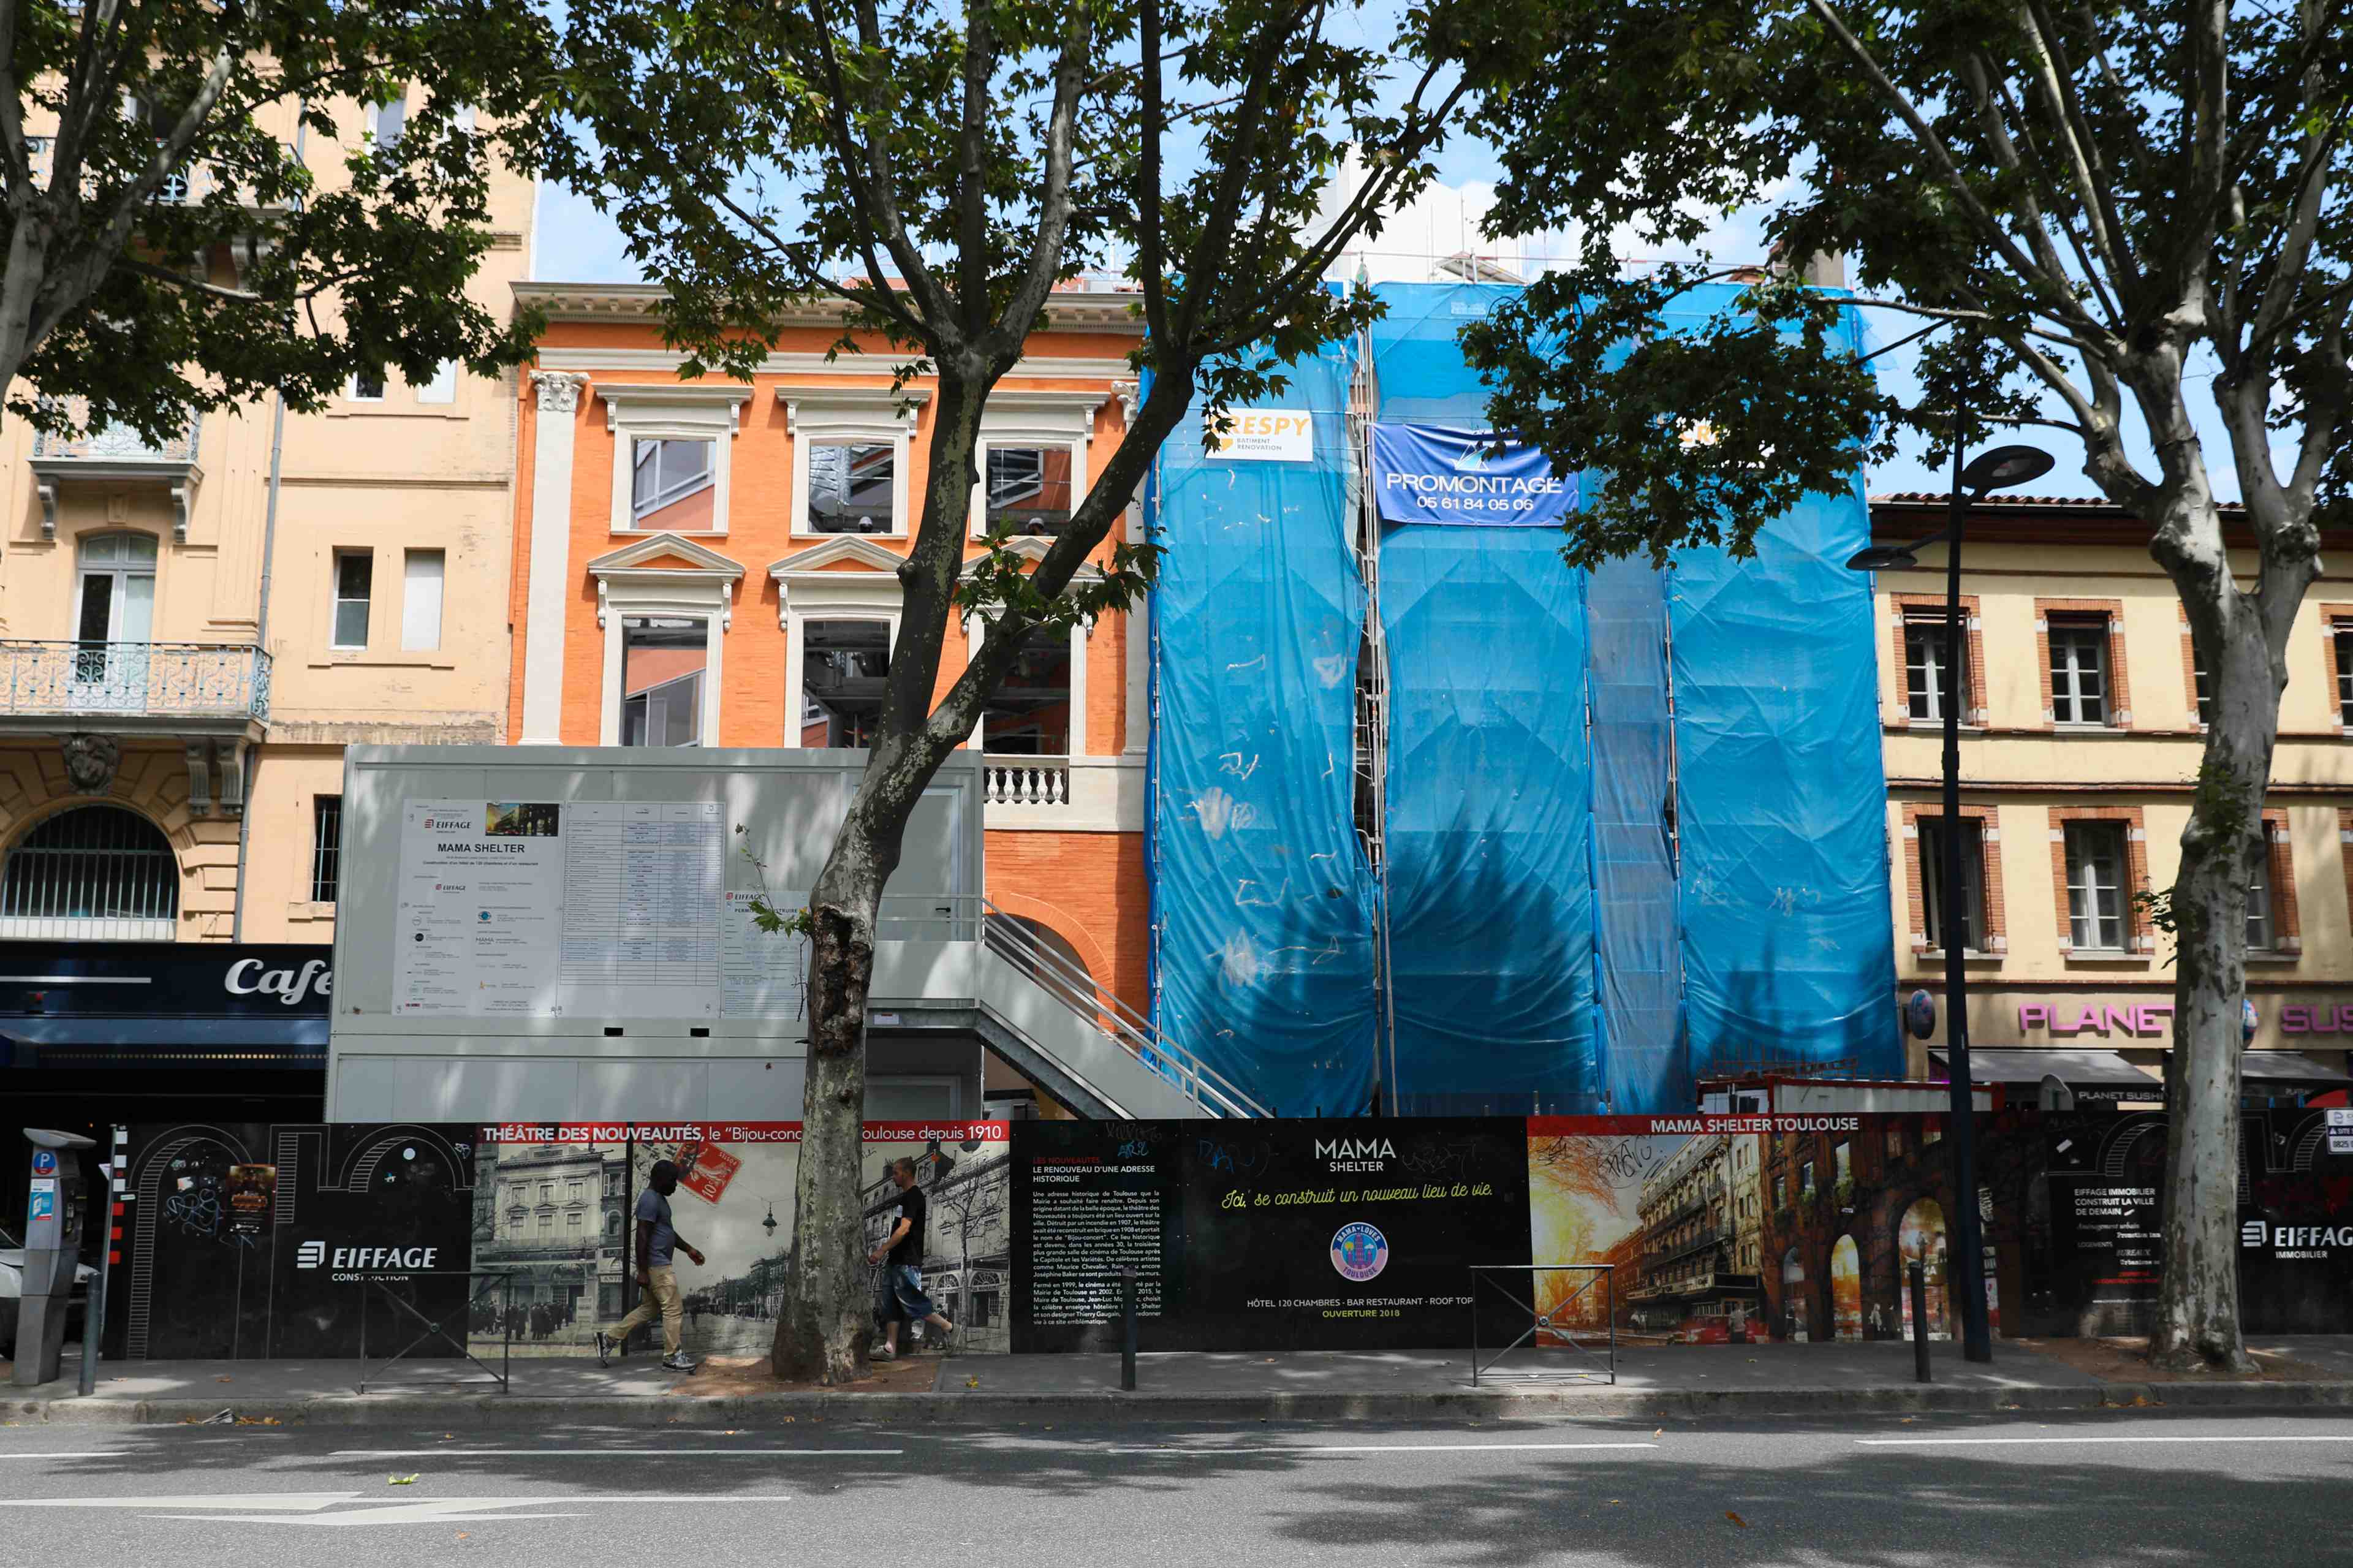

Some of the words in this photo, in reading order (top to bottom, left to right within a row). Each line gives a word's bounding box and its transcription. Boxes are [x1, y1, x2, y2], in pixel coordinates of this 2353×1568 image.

[1386, 472, 1563, 494] PROMONTAGE
[1417, 496, 1437, 509] 05
[1441, 497, 1459, 509] 61
[1463, 498, 1484, 510] 84
[1488, 499, 1509, 510] 05
[1513, 499, 1534, 510] 06
[436, 820, 471, 829] EIFFAGE
[438, 843, 471, 853] MAMA
[474, 844, 525, 854] SHELTER
[2078, 1091, 2124, 1100] PLANET
[1651, 1119, 1703, 1133] MAMA
[1707, 1118, 1771, 1132] SHELTER
[1775, 1117, 1859, 1131] TOULOUSE
[483, 1124, 555, 1141] THÉÂTRE
[558, 1127, 589, 1140] DES
[593, 1124, 705, 1142] NOUVEAUTÉS,
[709, 1126, 720, 1140] le
[861, 1127, 915, 1140] oulouse
[919, 1127, 964, 1143] depuis
[968, 1126, 1001, 1139] 1910
[1315, 1138, 1396, 1159] MAMA
[40, 1153, 50, 1167] P
[1330, 1161, 1384, 1172] SHELTER
[1254, 1192, 1270, 1206] se
[1275, 1187, 1335, 1205] construit
[1340, 1190, 1358, 1203] un
[1362, 1187, 1418, 1202] nouveau
[1422, 1183, 1447, 1199] lieu
[1451, 1182, 1468, 1197] de
[1472, 1181, 1493, 1196] vie.
[1336, 1225, 1357, 1243] MAMA
[1360, 1225, 1381, 1242] LOVES
[2275, 1227, 2353, 1247] EIFFAG
[332, 1248, 438, 1268] EIFFAGE
[1342, 1266, 1378, 1279] TOULOUSE
[1247, 1297, 1276, 1307] HÔTEL
[1294, 1298, 1341, 1307] CHAMBRES
[1379, 1309, 1400, 1317] 2018
